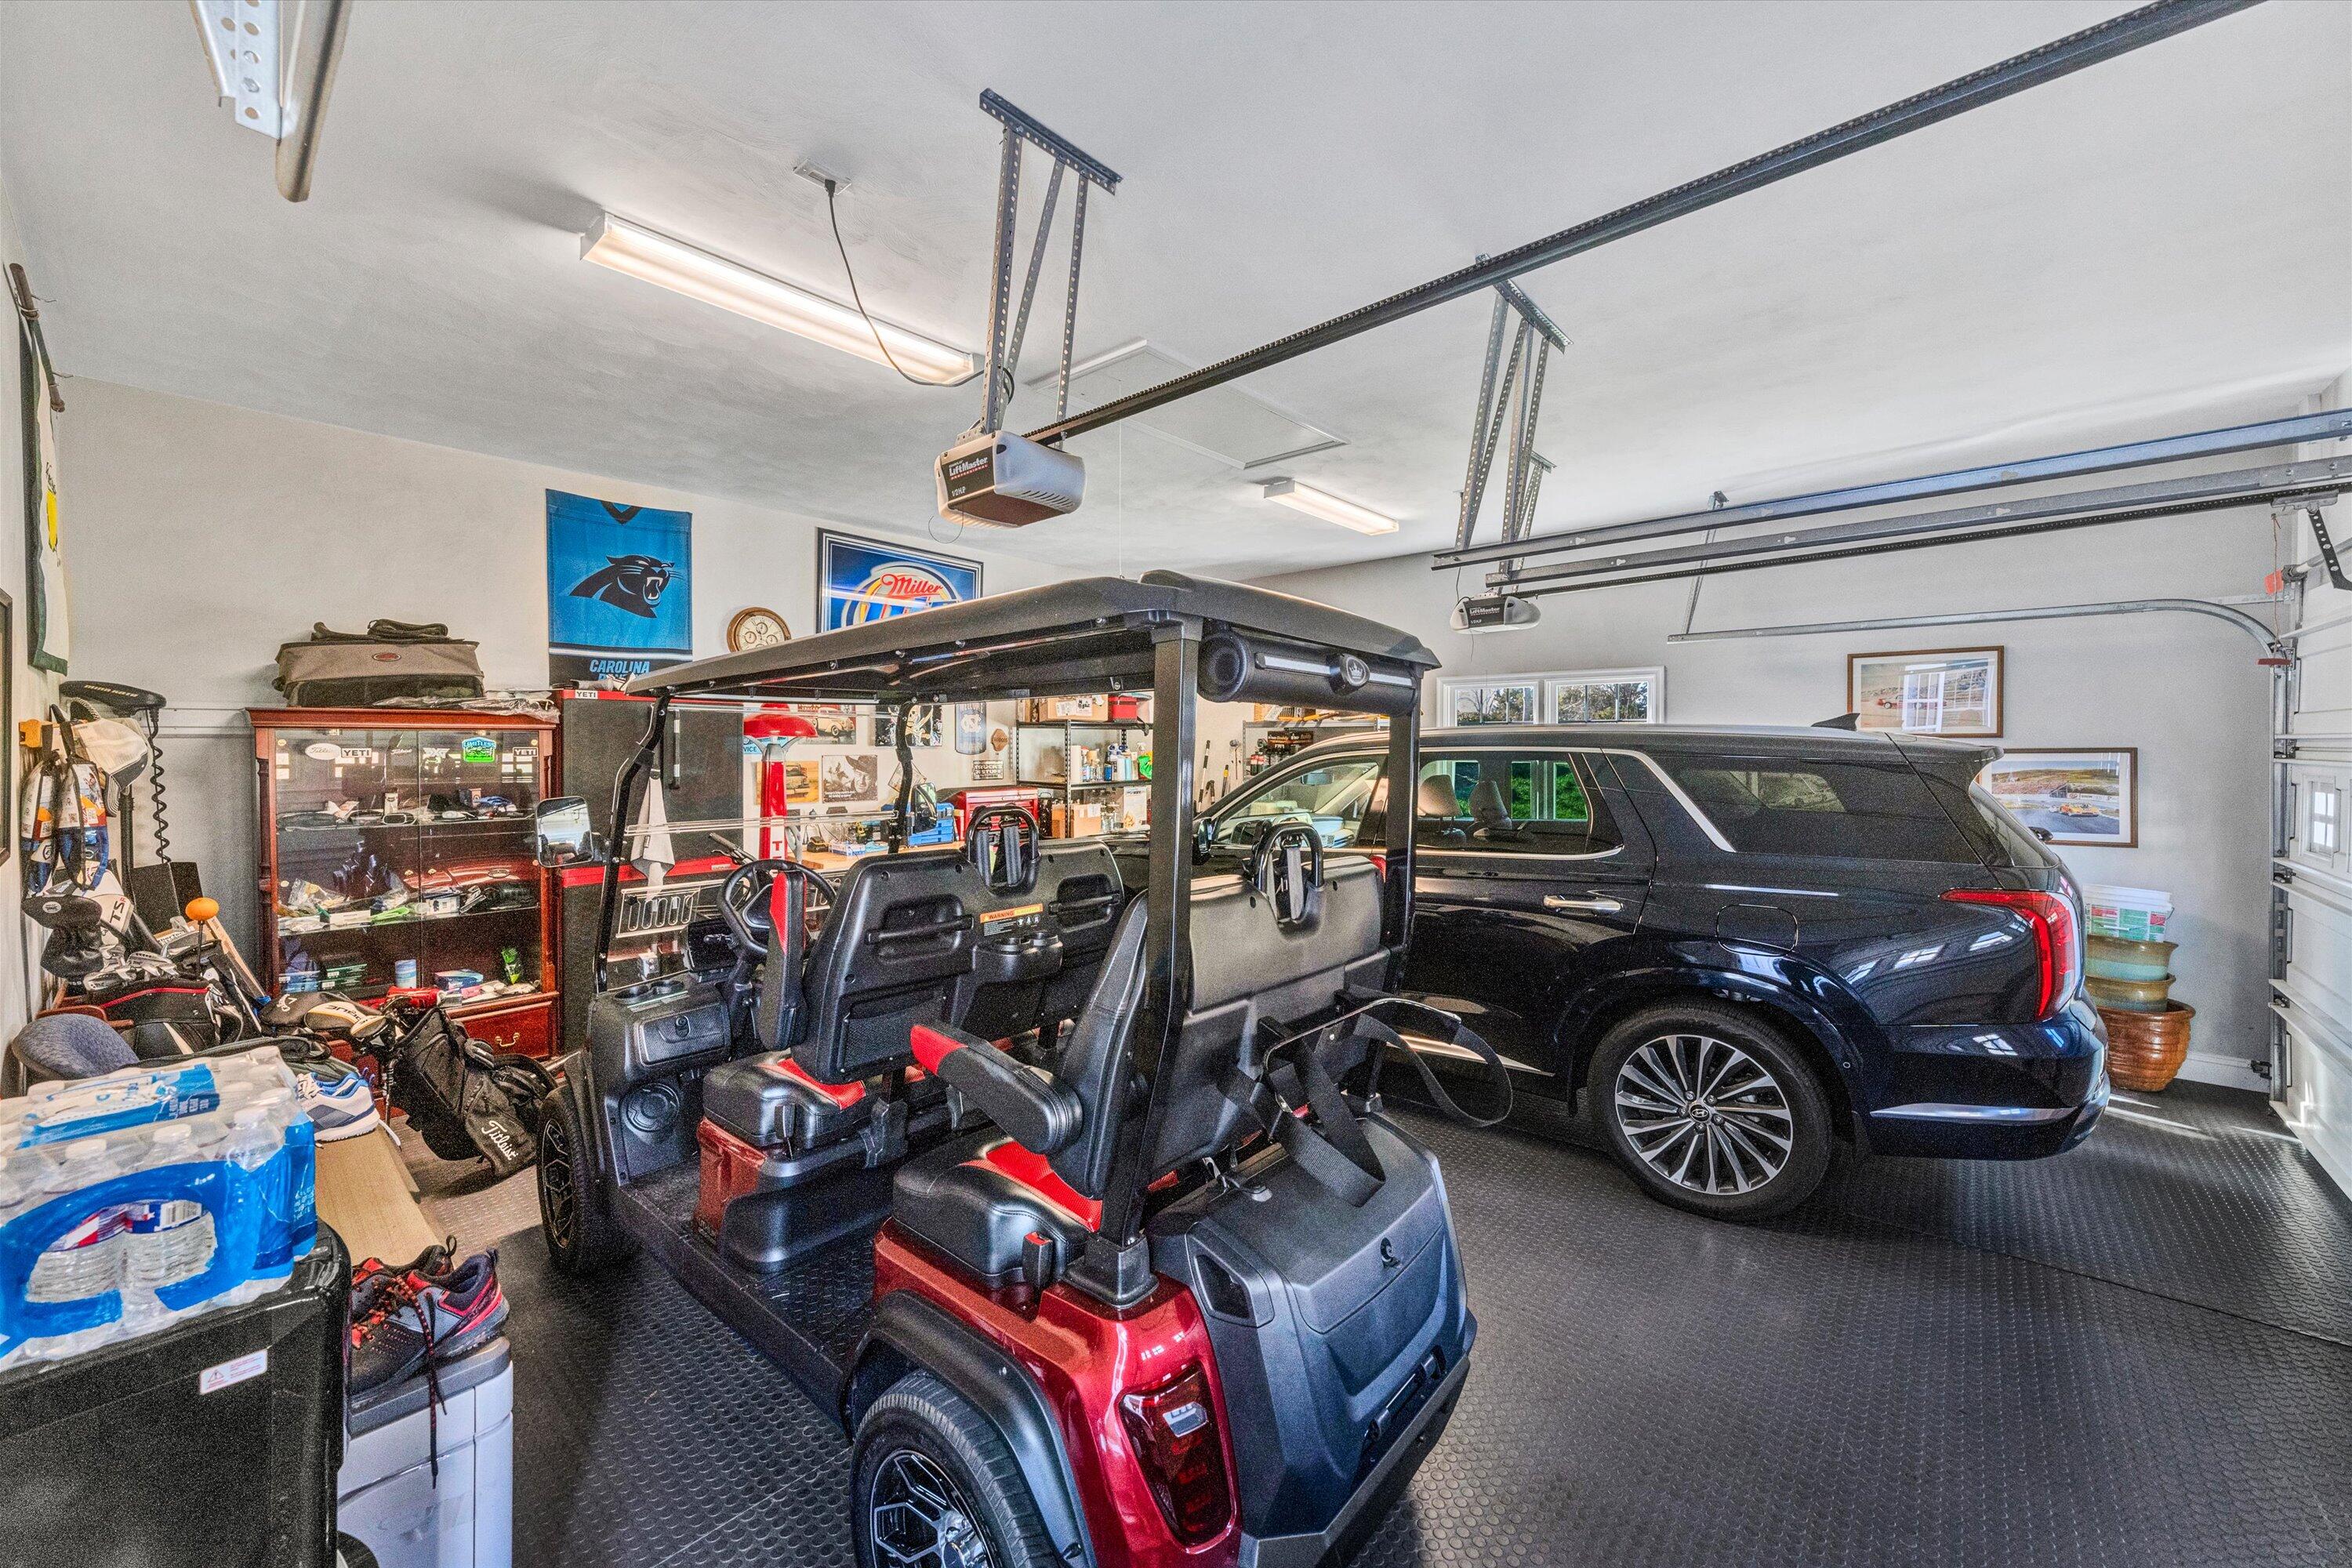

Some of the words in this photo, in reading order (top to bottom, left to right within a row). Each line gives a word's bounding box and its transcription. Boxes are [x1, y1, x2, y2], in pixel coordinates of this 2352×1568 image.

[949, 457, 988, 477] LiftMaster
[881, 574, 943, 598] Miller
[590, 659, 650, 673] CAROLINA
[989, 910, 1014, 920] WARNING
[481, 1120, 518, 1160] Titleist
